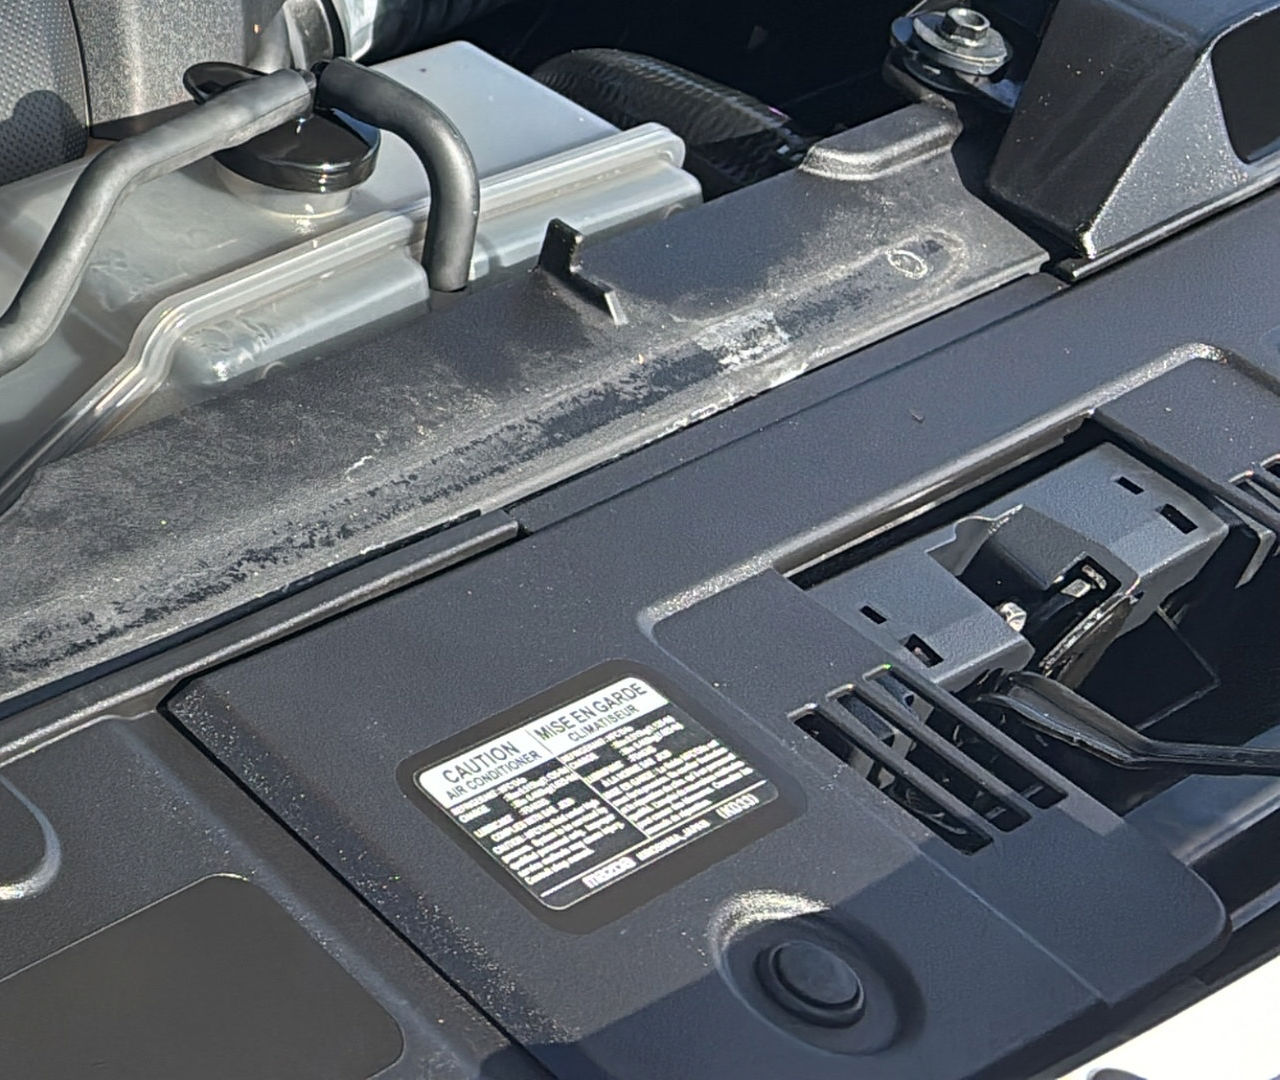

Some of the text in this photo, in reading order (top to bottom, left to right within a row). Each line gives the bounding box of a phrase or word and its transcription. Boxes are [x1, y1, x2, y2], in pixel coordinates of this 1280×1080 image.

[532, 682, 648, 740] MISE EN GARDE
[565, 703, 640, 742] CLIMATISEUR
[439, 740, 521, 784] CAUTION
[443, 784, 467, 800] AIR
[464, 749, 543, 790] CONDITIONER
